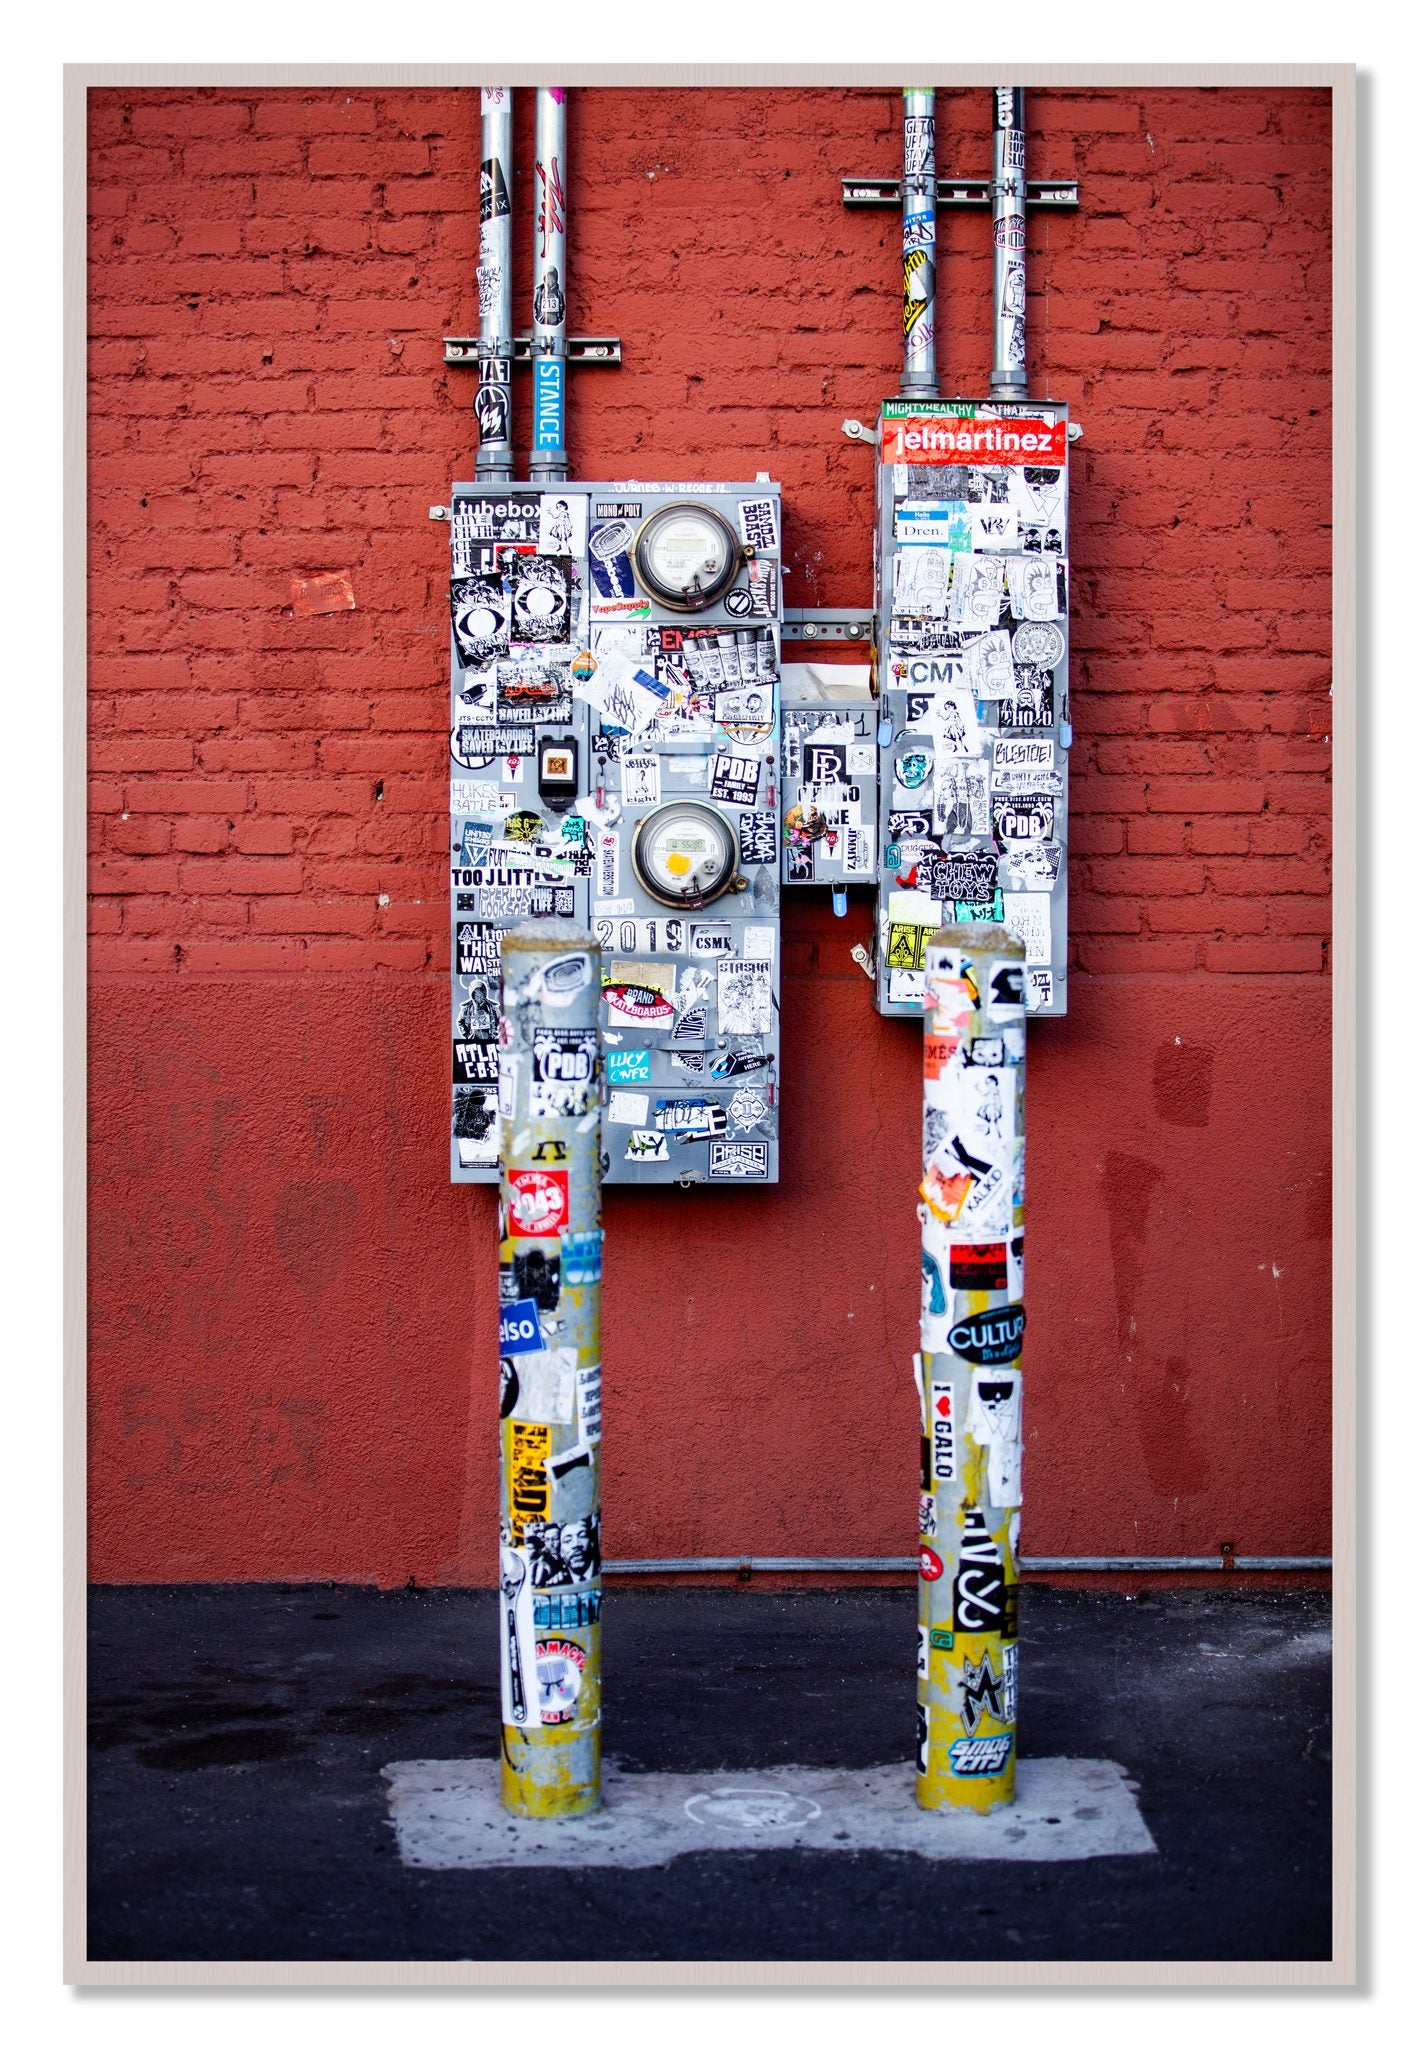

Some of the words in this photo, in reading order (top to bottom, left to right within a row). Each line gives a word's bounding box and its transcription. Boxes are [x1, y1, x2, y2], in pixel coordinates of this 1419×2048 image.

[542, 299, 557, 309] 213
[540, 364, 560, 445] STANCE
[886, 402, 972, 417] MIGHTYHEALTHY
[896, 426, 1052, 454] jelmartinez
[454, 527, 493, 539] FILTH
[716, 757, 761, 783] PDB
[732, 791, 754, 803] 1993
[1005, 816, 1042, 837] PDB
[932, 861, 994, 881] CHEW
[937, 881, 990, 900] TOYS
[892, 925, 916, 934] ARISE
[695, 937, 732, 951] CSMK
[550, 1052, 590, 1080] PDB
[610, 1051, 646, 1068] LUCY
[712, 1144, 765, 1163] ARISE
[934, 1421, 953, 1478] GALO
[955, 1753, 1005, 1772] CITY
